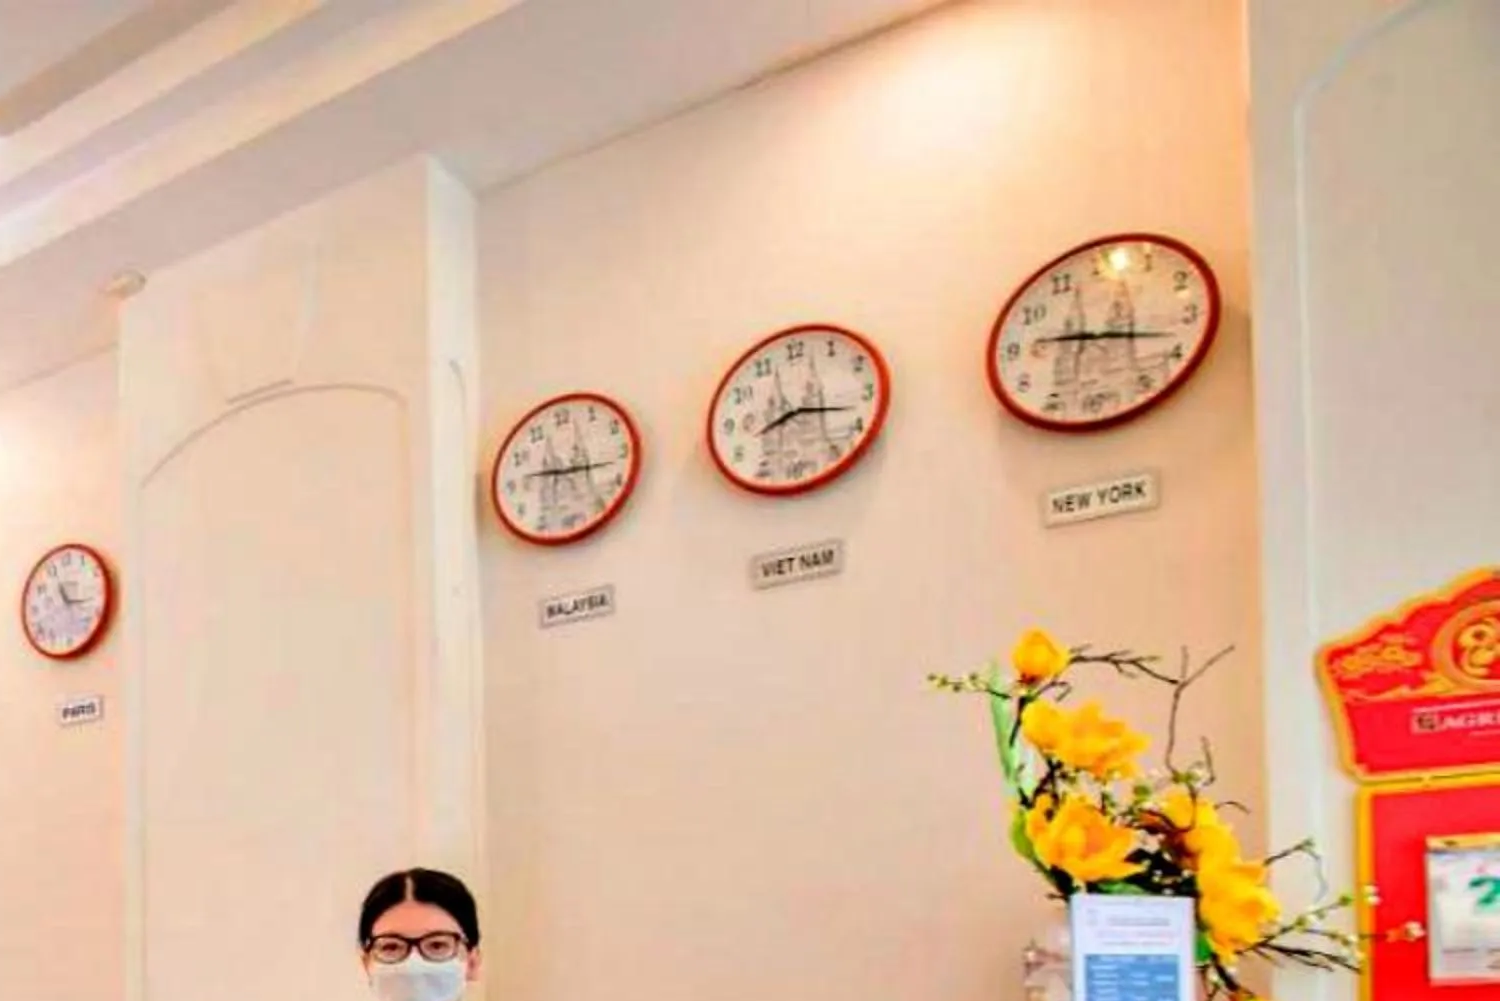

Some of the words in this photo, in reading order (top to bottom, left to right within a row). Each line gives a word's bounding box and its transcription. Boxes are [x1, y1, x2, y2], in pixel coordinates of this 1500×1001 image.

[1052, 491, 1092, 513] NEW
[1097, 480, 1147, 506] YORK
[760, 556, 795, 577] VIET
[799, 549, 835, 569] NAM
